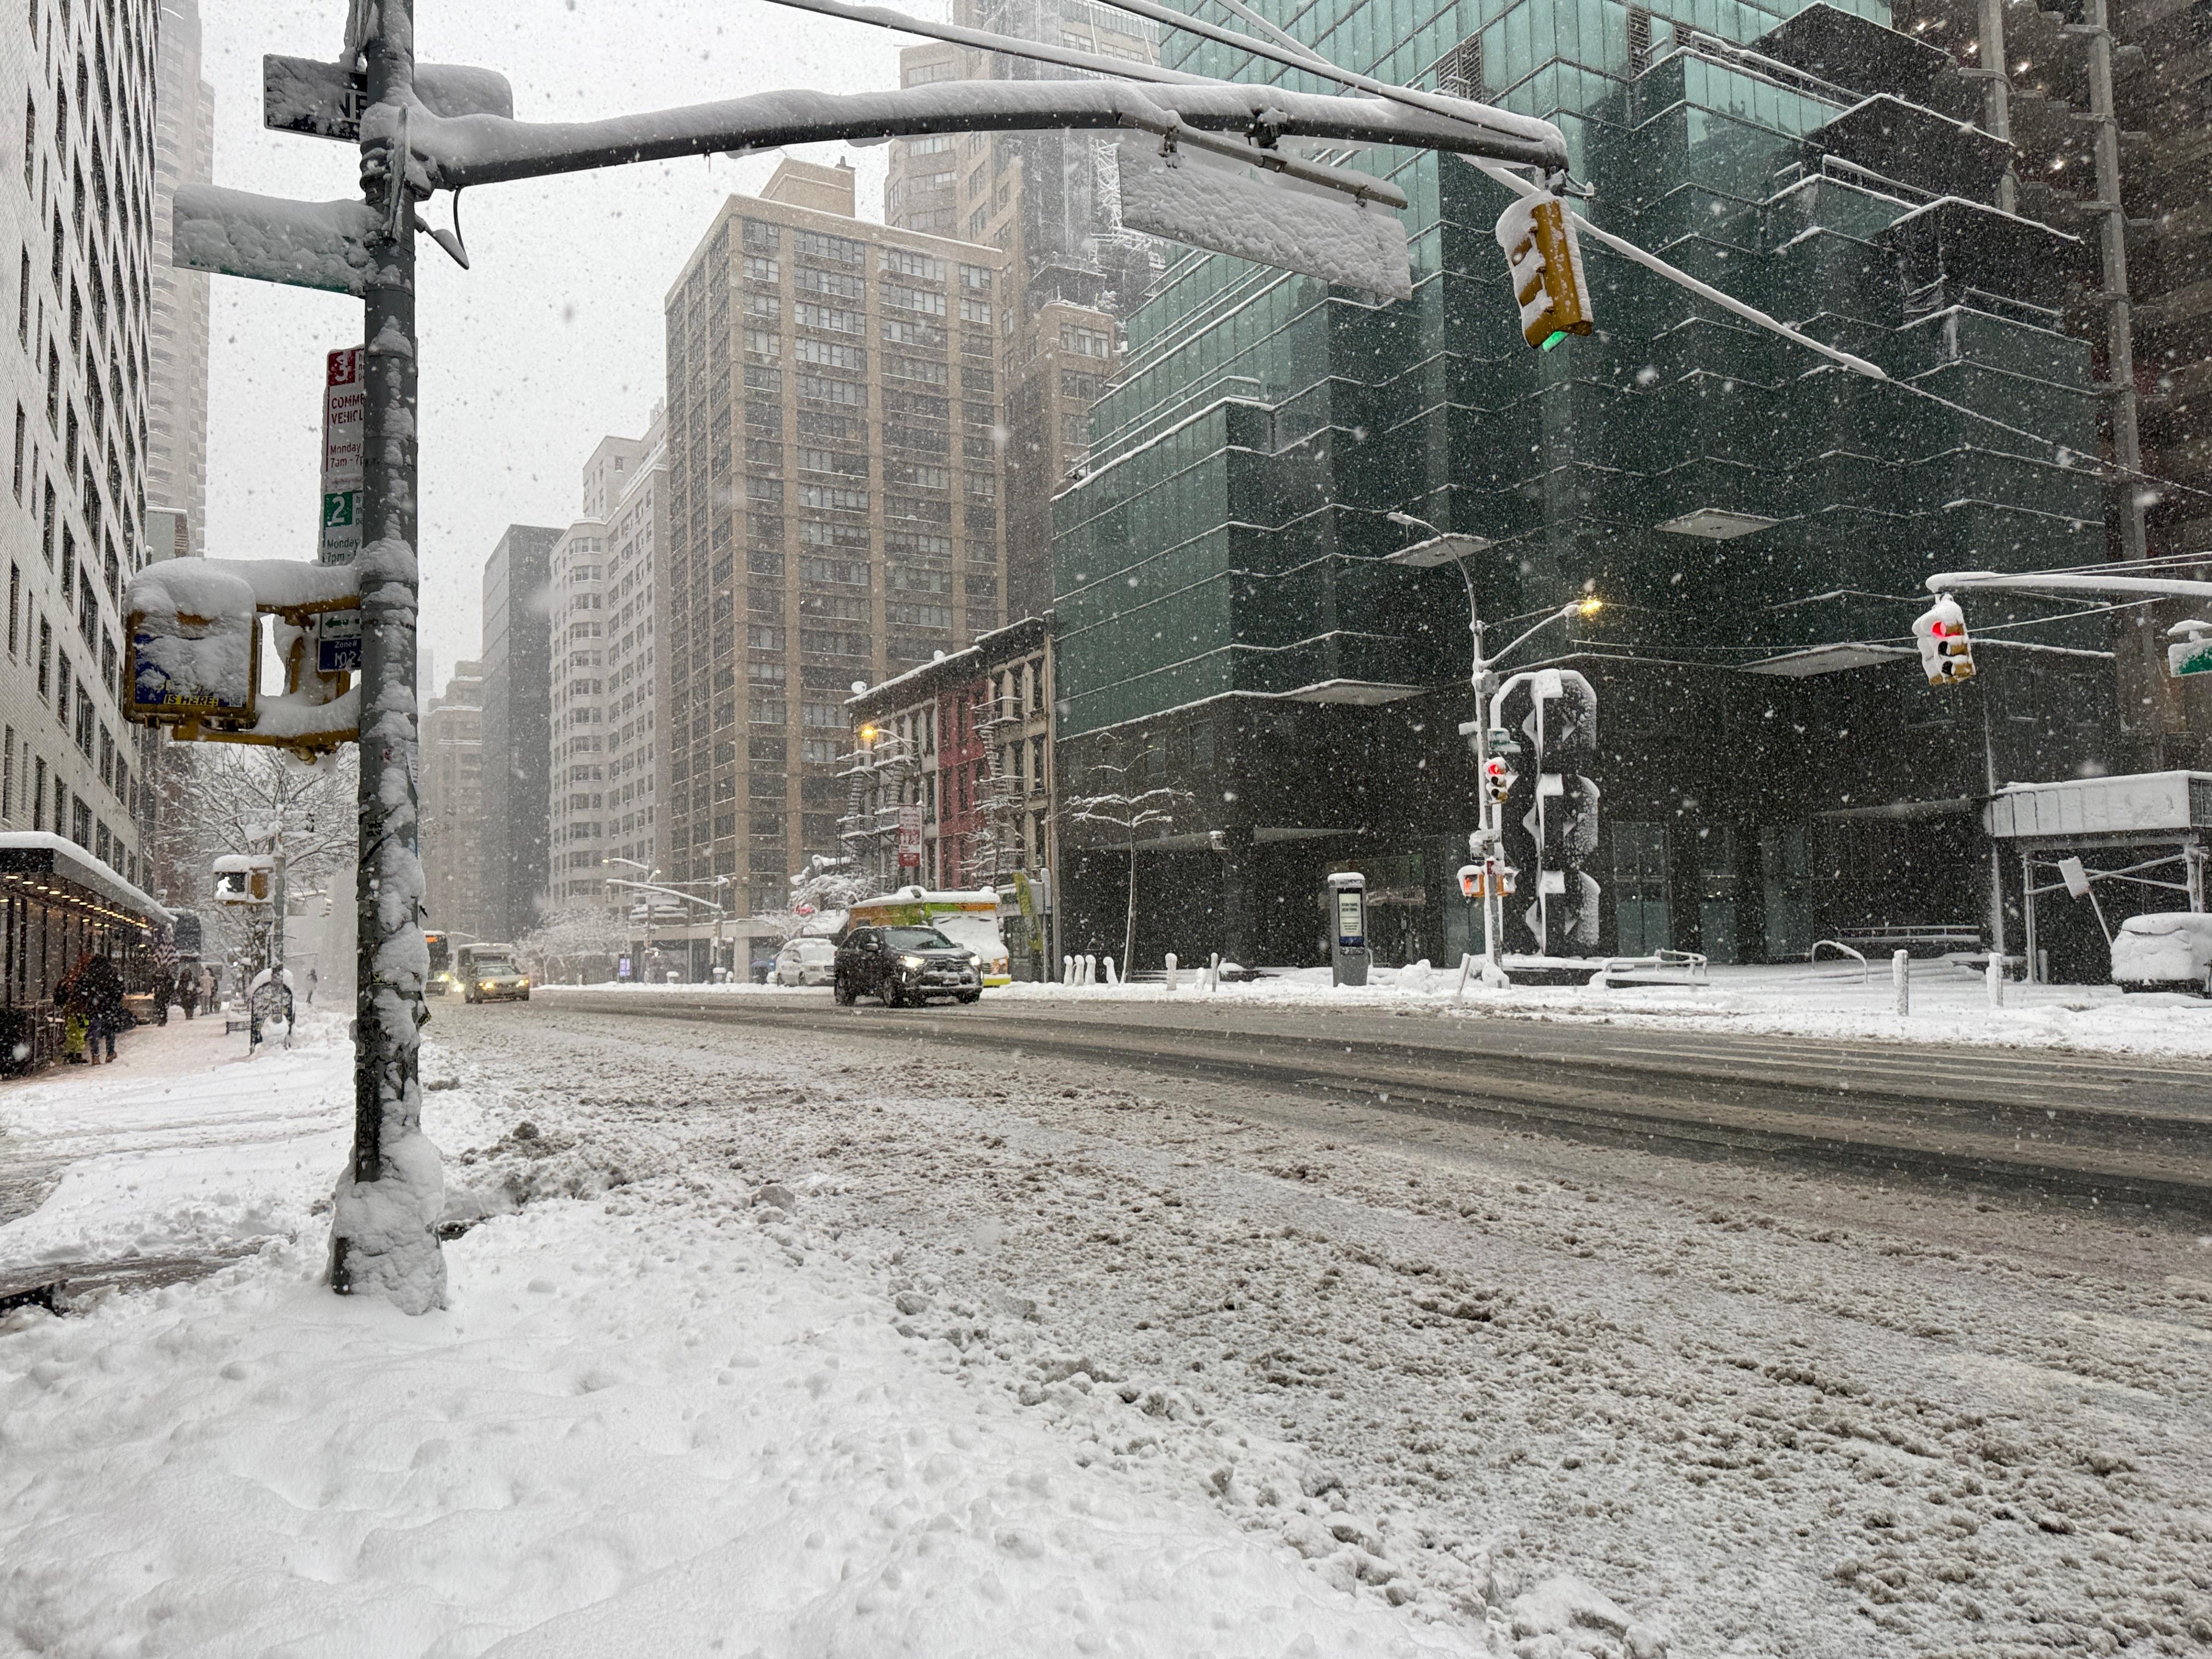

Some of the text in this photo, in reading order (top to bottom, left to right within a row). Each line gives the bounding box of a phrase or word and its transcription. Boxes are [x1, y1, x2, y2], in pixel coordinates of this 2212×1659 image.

[338, 92, 368, 120] NE
[331, 409, 363, 425] VEHICL
[330, 442, 361, 455] Monday
[330, 458, 347, 468] 7am
[355, 454, 363, 467] 7p
[332, 495, 345, 523] 2
[327, 537, 360, 550] Monday
[327, 552, 345, 564] 7pm
[335, 640, 357, 648] Zone#
[165, 695, 177, 704] IS
